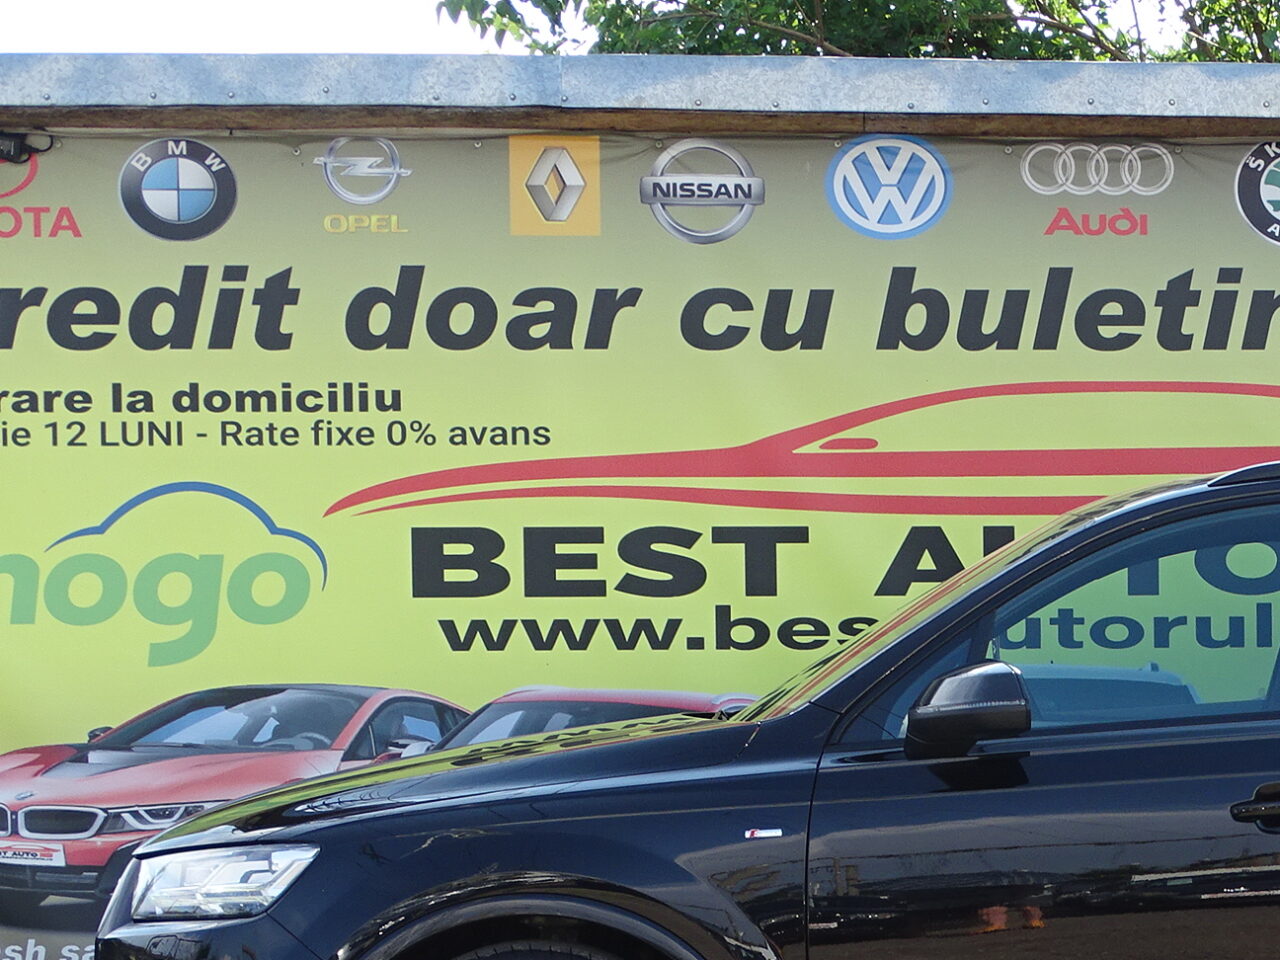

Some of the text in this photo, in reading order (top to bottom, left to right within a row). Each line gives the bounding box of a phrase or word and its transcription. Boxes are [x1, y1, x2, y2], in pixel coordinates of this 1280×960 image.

[131, 139, 225, 173] BMW
[652, 180, 752, 200] NISSAN
[323, 214, 409, 233] OPEL
[1043, 207, 1149, 236] Audi
[0, 265, 301, 350] redit
[344, 265, 643, 350] doar
[680, 287, 834, 350] cu
[111, 382, 154, 413] la
[172, 382, 402, 413] domiciliu
[1, 420, 31, 447] ie
[44, 421, 87, 446] 12
[100, 421, 184, 447] LUNI
[220, 421, 300, 446] Rate
[311, 420, 375, 446] fixe
[387, 421, 437, 446] 0%
[449, 428, 551, 447] avans
[411, 526, 809, 597] BEST
